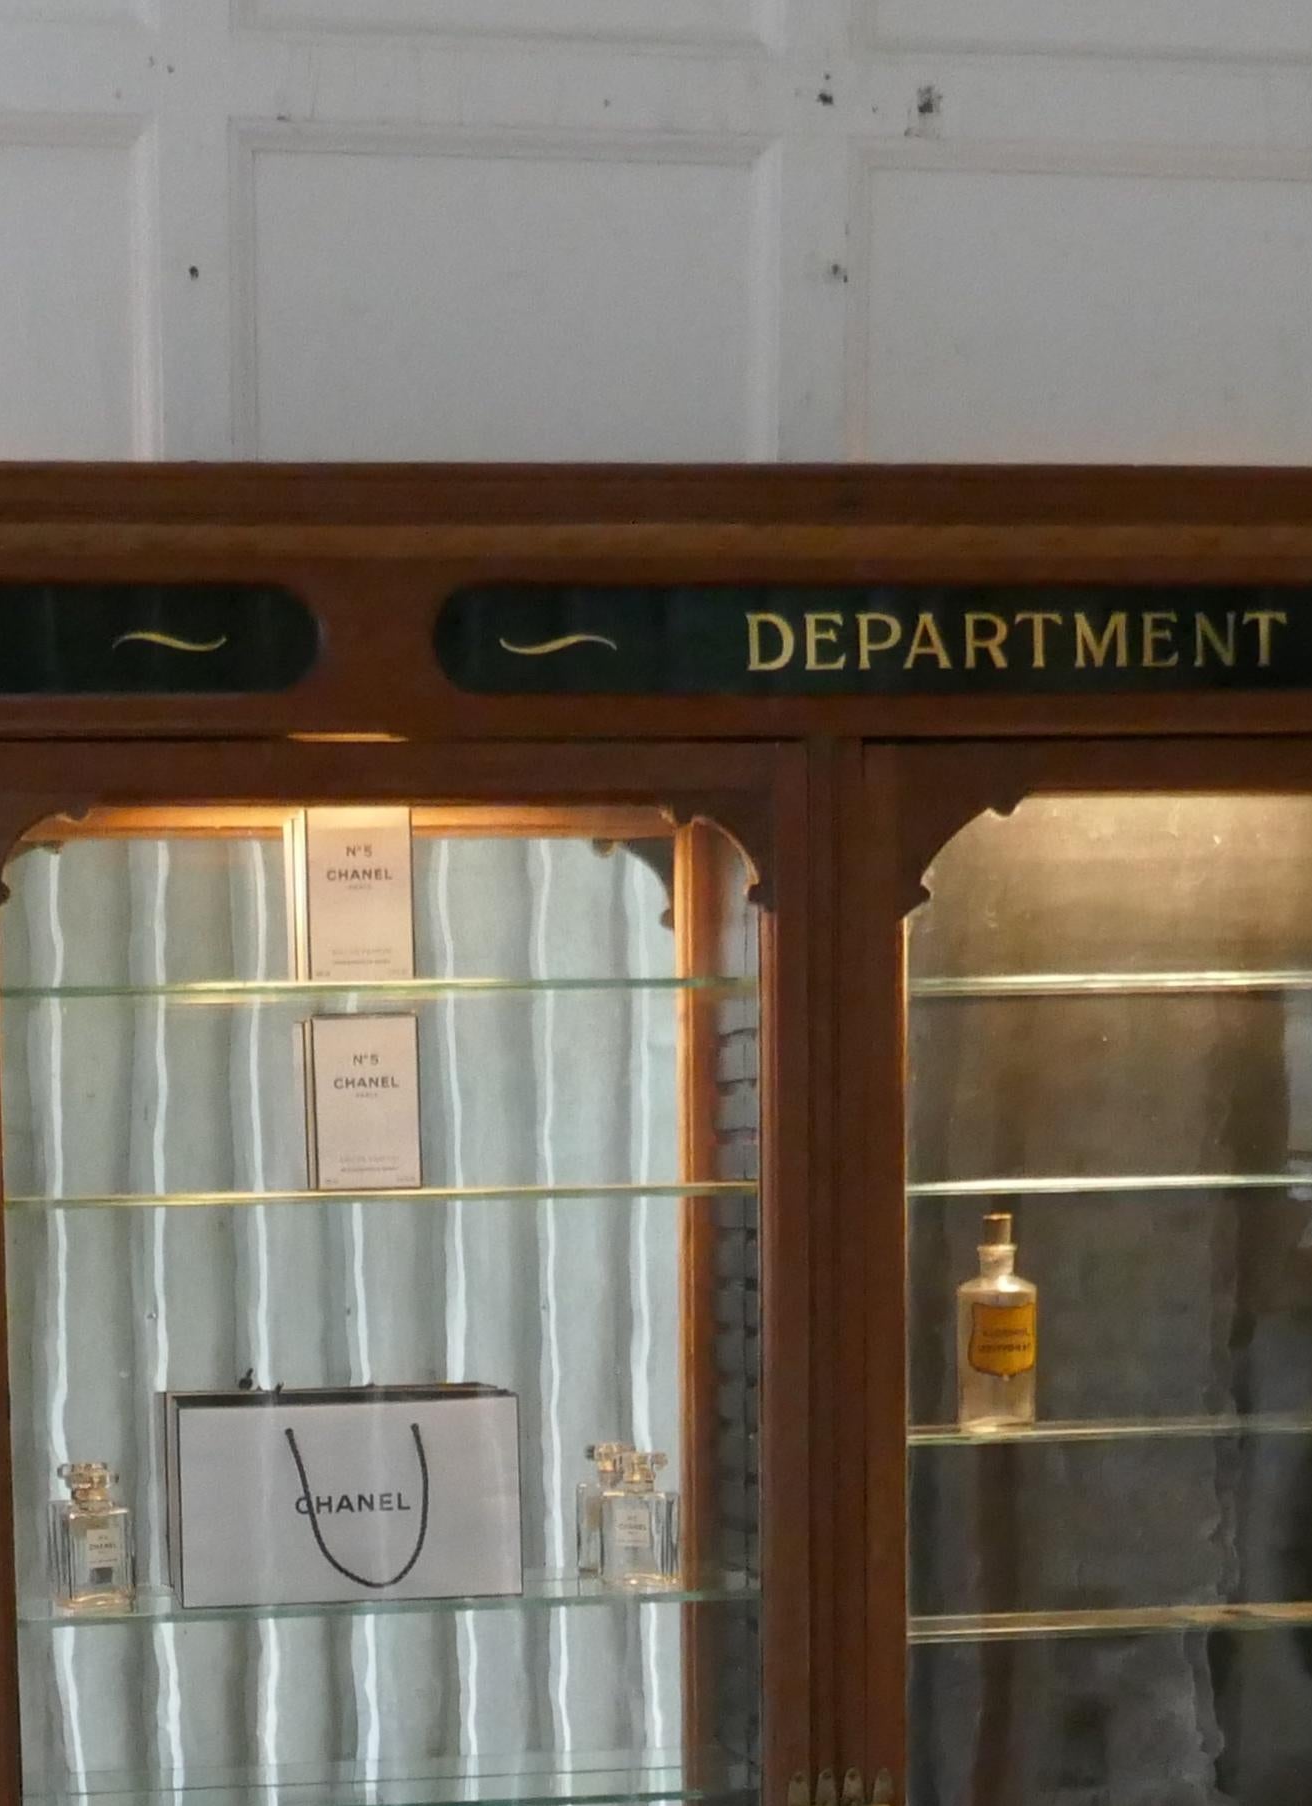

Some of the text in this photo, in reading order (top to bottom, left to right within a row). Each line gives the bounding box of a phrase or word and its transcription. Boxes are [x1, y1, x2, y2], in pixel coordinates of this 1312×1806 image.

[745, 609, 1287, 671] DEPARTMENT
[326, 867, 393, 882] CHANEL
[333, 1075, 400, 1090] CHANEL
[295, 1491, 412, 1515] CHANEL
